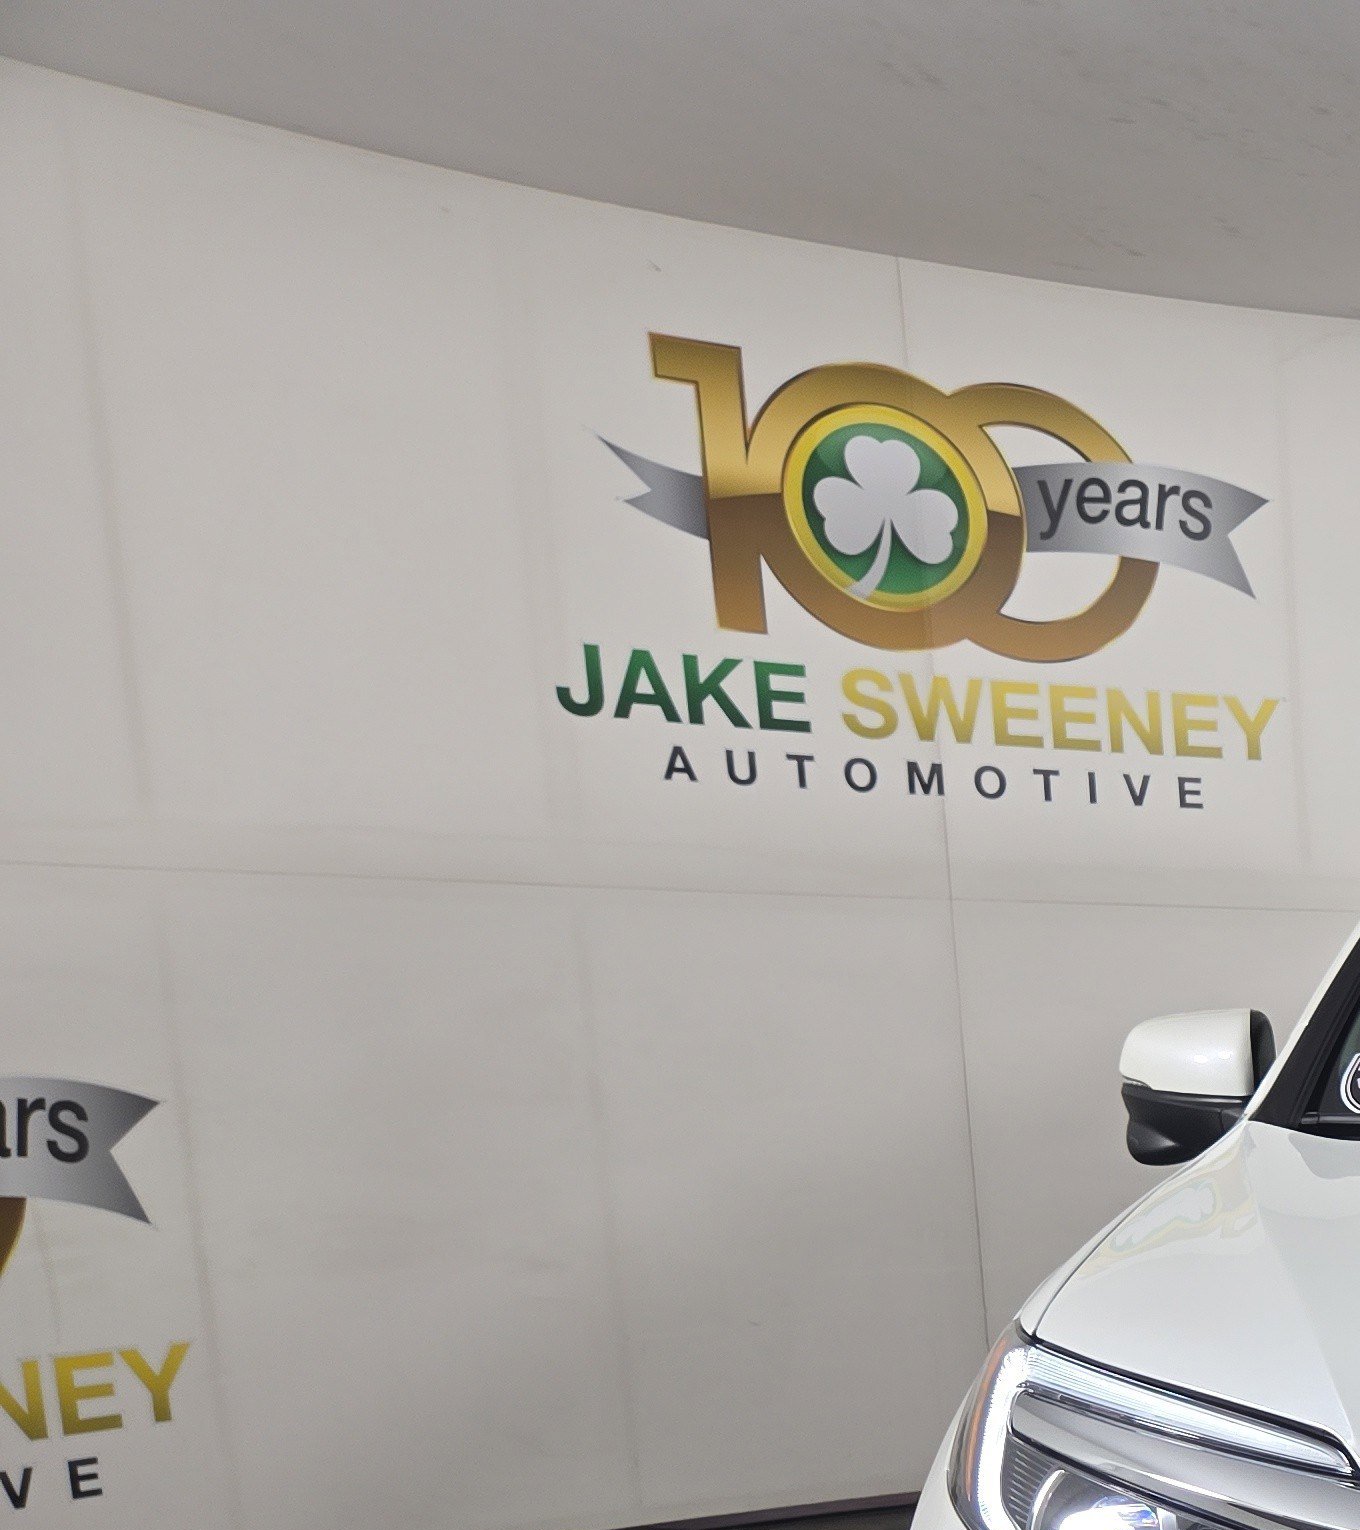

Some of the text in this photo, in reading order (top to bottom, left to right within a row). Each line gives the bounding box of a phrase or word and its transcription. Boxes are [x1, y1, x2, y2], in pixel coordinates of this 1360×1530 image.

[1037, 472, 1215, 543] years
[555, 642, 1282, 762] JAKE SWEENEY
[663, 745, 1205, 810] AUTOMOTIVE
[0, 1457, 104, 1510] VE
